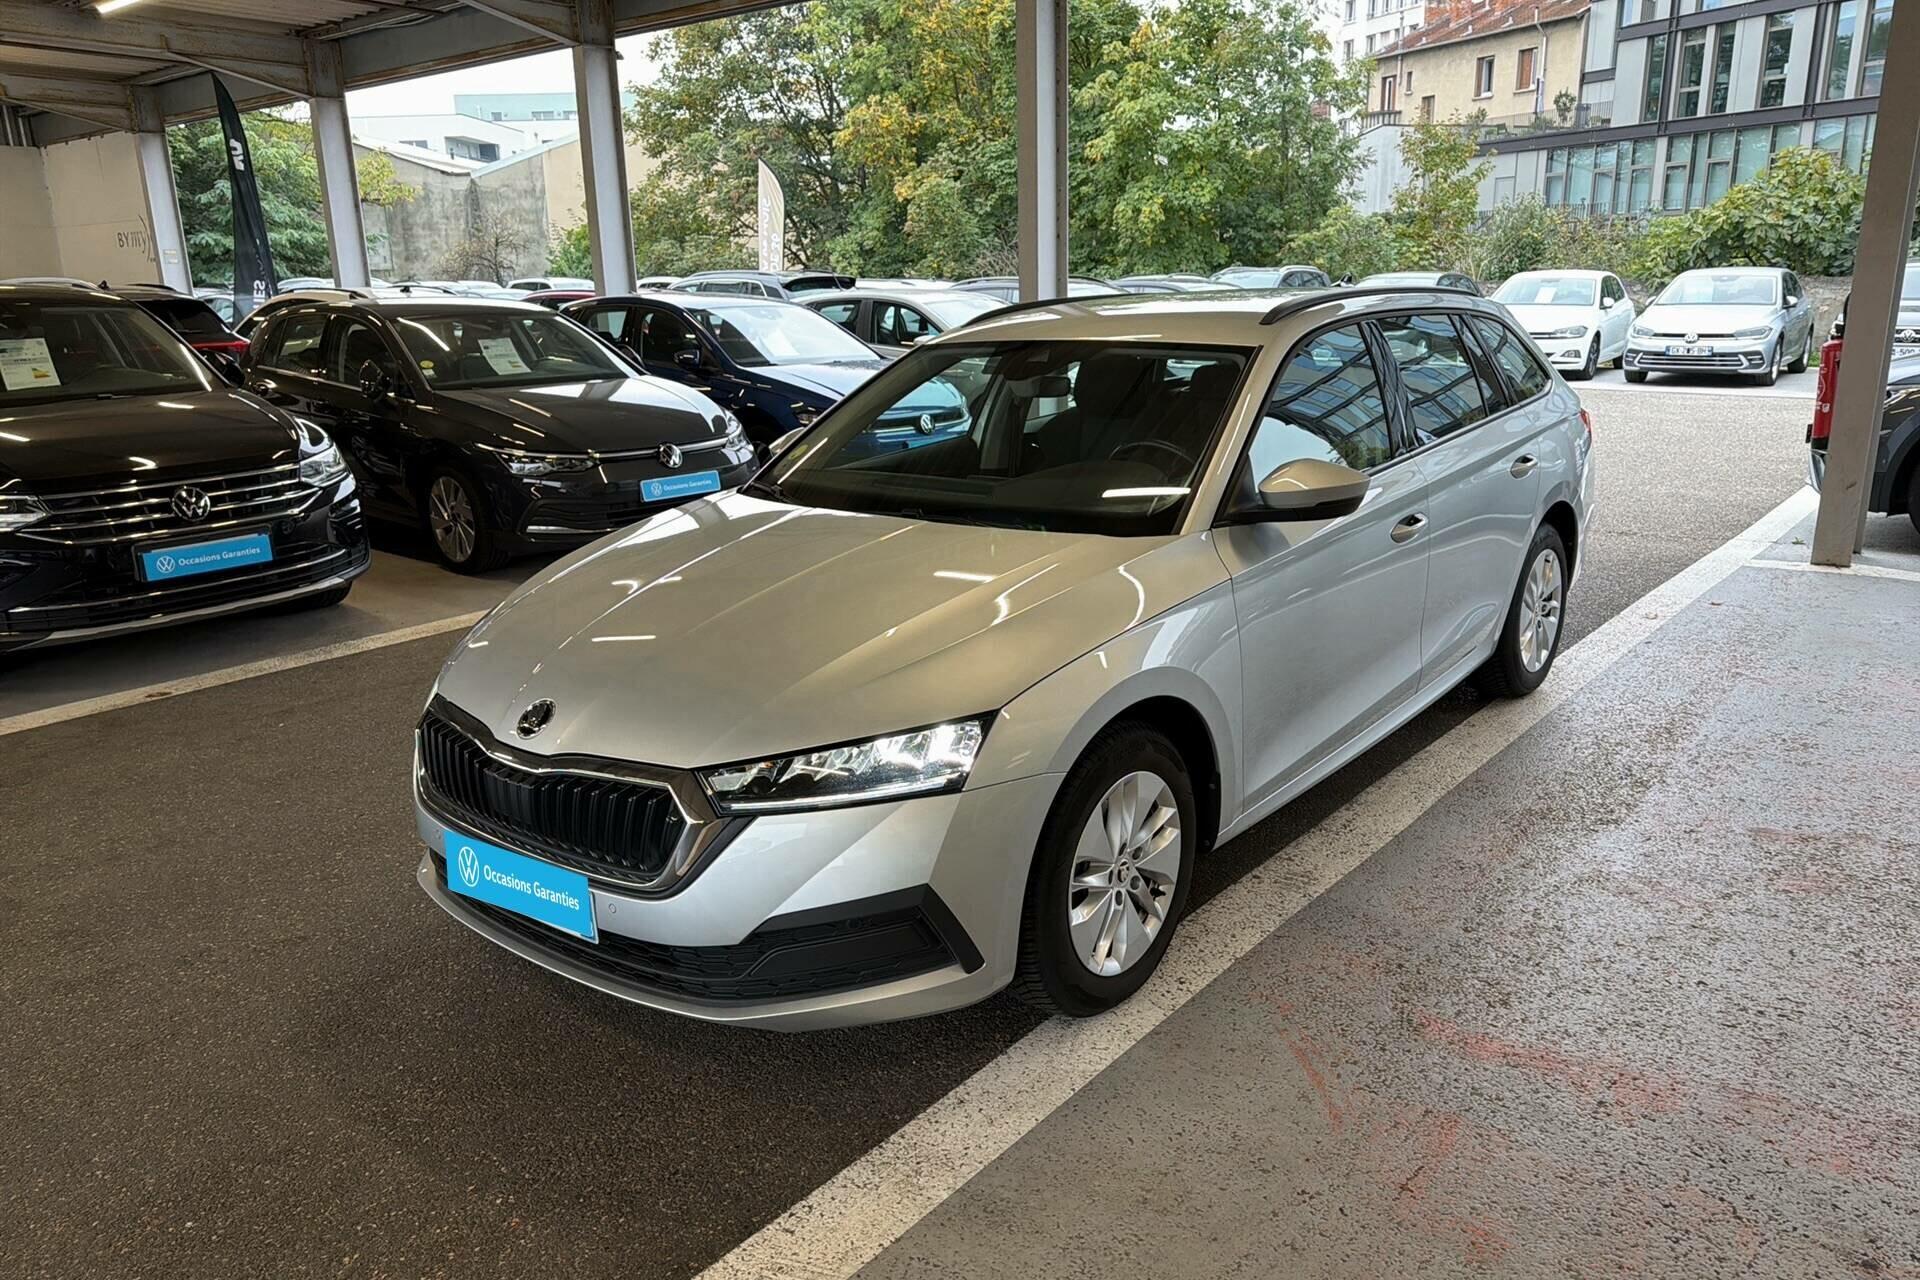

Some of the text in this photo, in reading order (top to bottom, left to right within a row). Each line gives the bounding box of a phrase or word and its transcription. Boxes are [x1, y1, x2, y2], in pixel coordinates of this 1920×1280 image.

[116, 231, 129, 248] BY
[178, 553, 221, 567] Occasions
[222, 545, 261, 560] Garanties
[483, 864, 532, 895] Occasions
[533, 882, 580, 911] Garanties
